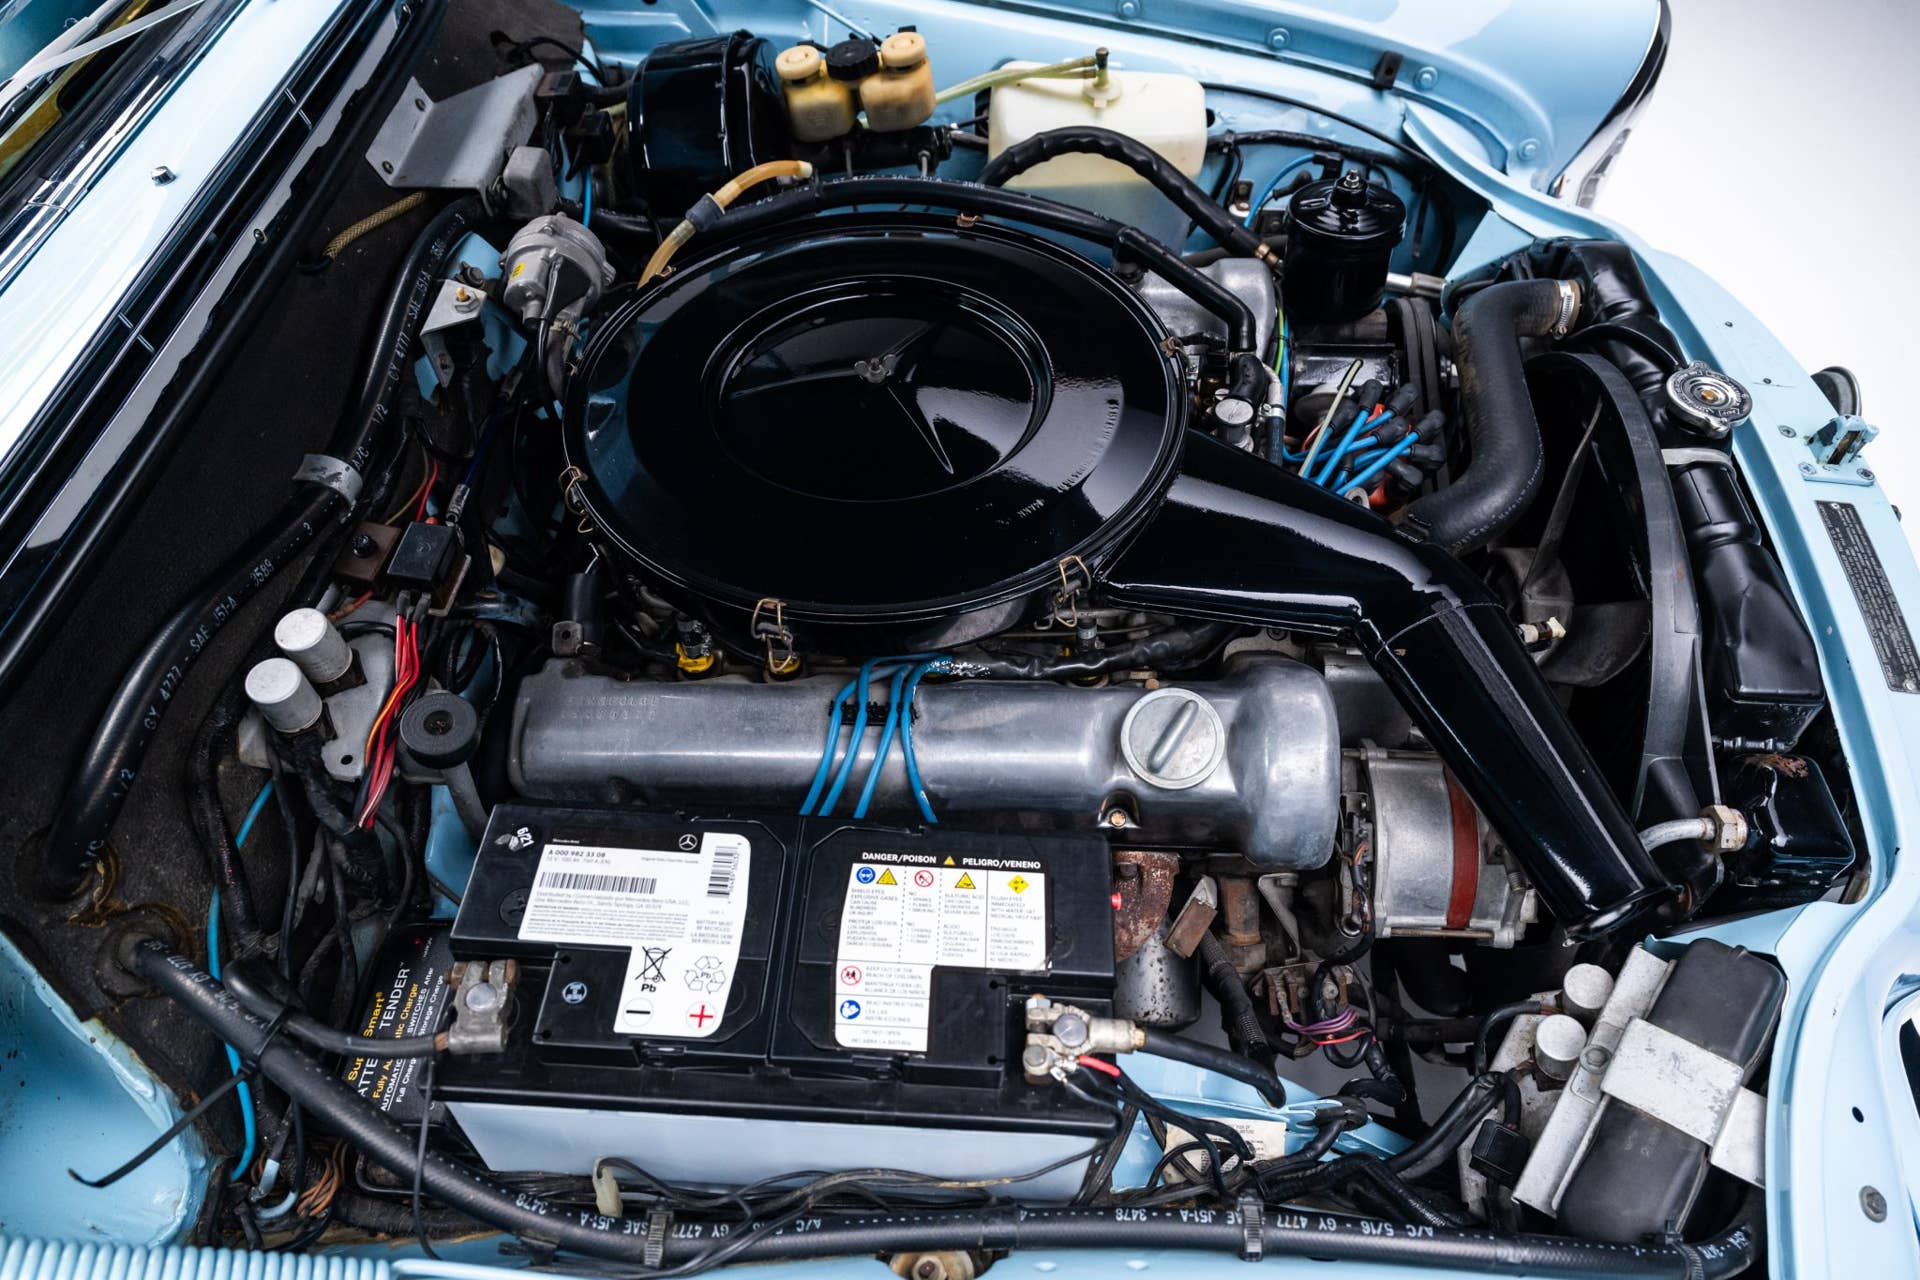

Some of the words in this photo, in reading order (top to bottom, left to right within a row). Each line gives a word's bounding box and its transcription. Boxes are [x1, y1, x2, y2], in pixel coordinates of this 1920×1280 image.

[408, 296, 421, 320] SAE
[143, 705, 161, 730] GY
[159, 665, 182, 701] 4777
[190, 625, 211, 652] SAE
[516, 826, 534, 848] 6/21
[862, 852, 937, 865] DANGER/POISON
[962, 857, 1041, 870] PELIGRO/VENENO
[641, 983, 656, 992] Pb
[407, 989, 427, 1034] SWITCHES
[424, 967, 434, 986] After
[372, 1077, 388, 1099] Fully
[400, 983, 419, 1020] Charger
[396, 1087, 406, 1103] Full
[403, 1057, 417, 1084] Charg
[430, 975, 444, 1004] Charge
[515, 1192, 549, 1216] 3478
[580, 1211, 616, 1231] J51-A
[1115, 1207, 1148, 1222] 3478
[1180, 1209, 1216, 1225] J51-A
[1276, 1214, 1307, 1230] 4777
[624, 1220, 649, 1236] SAE
[711, 1223, 730, 1238] GY
[795, 1217, 822, 1232] A/C
[1318, 1216, 1337, 1232] GY
[1361, 1220, 1395, 1237] 5/16
[1406, 1223, 1434, 1238] A/C
